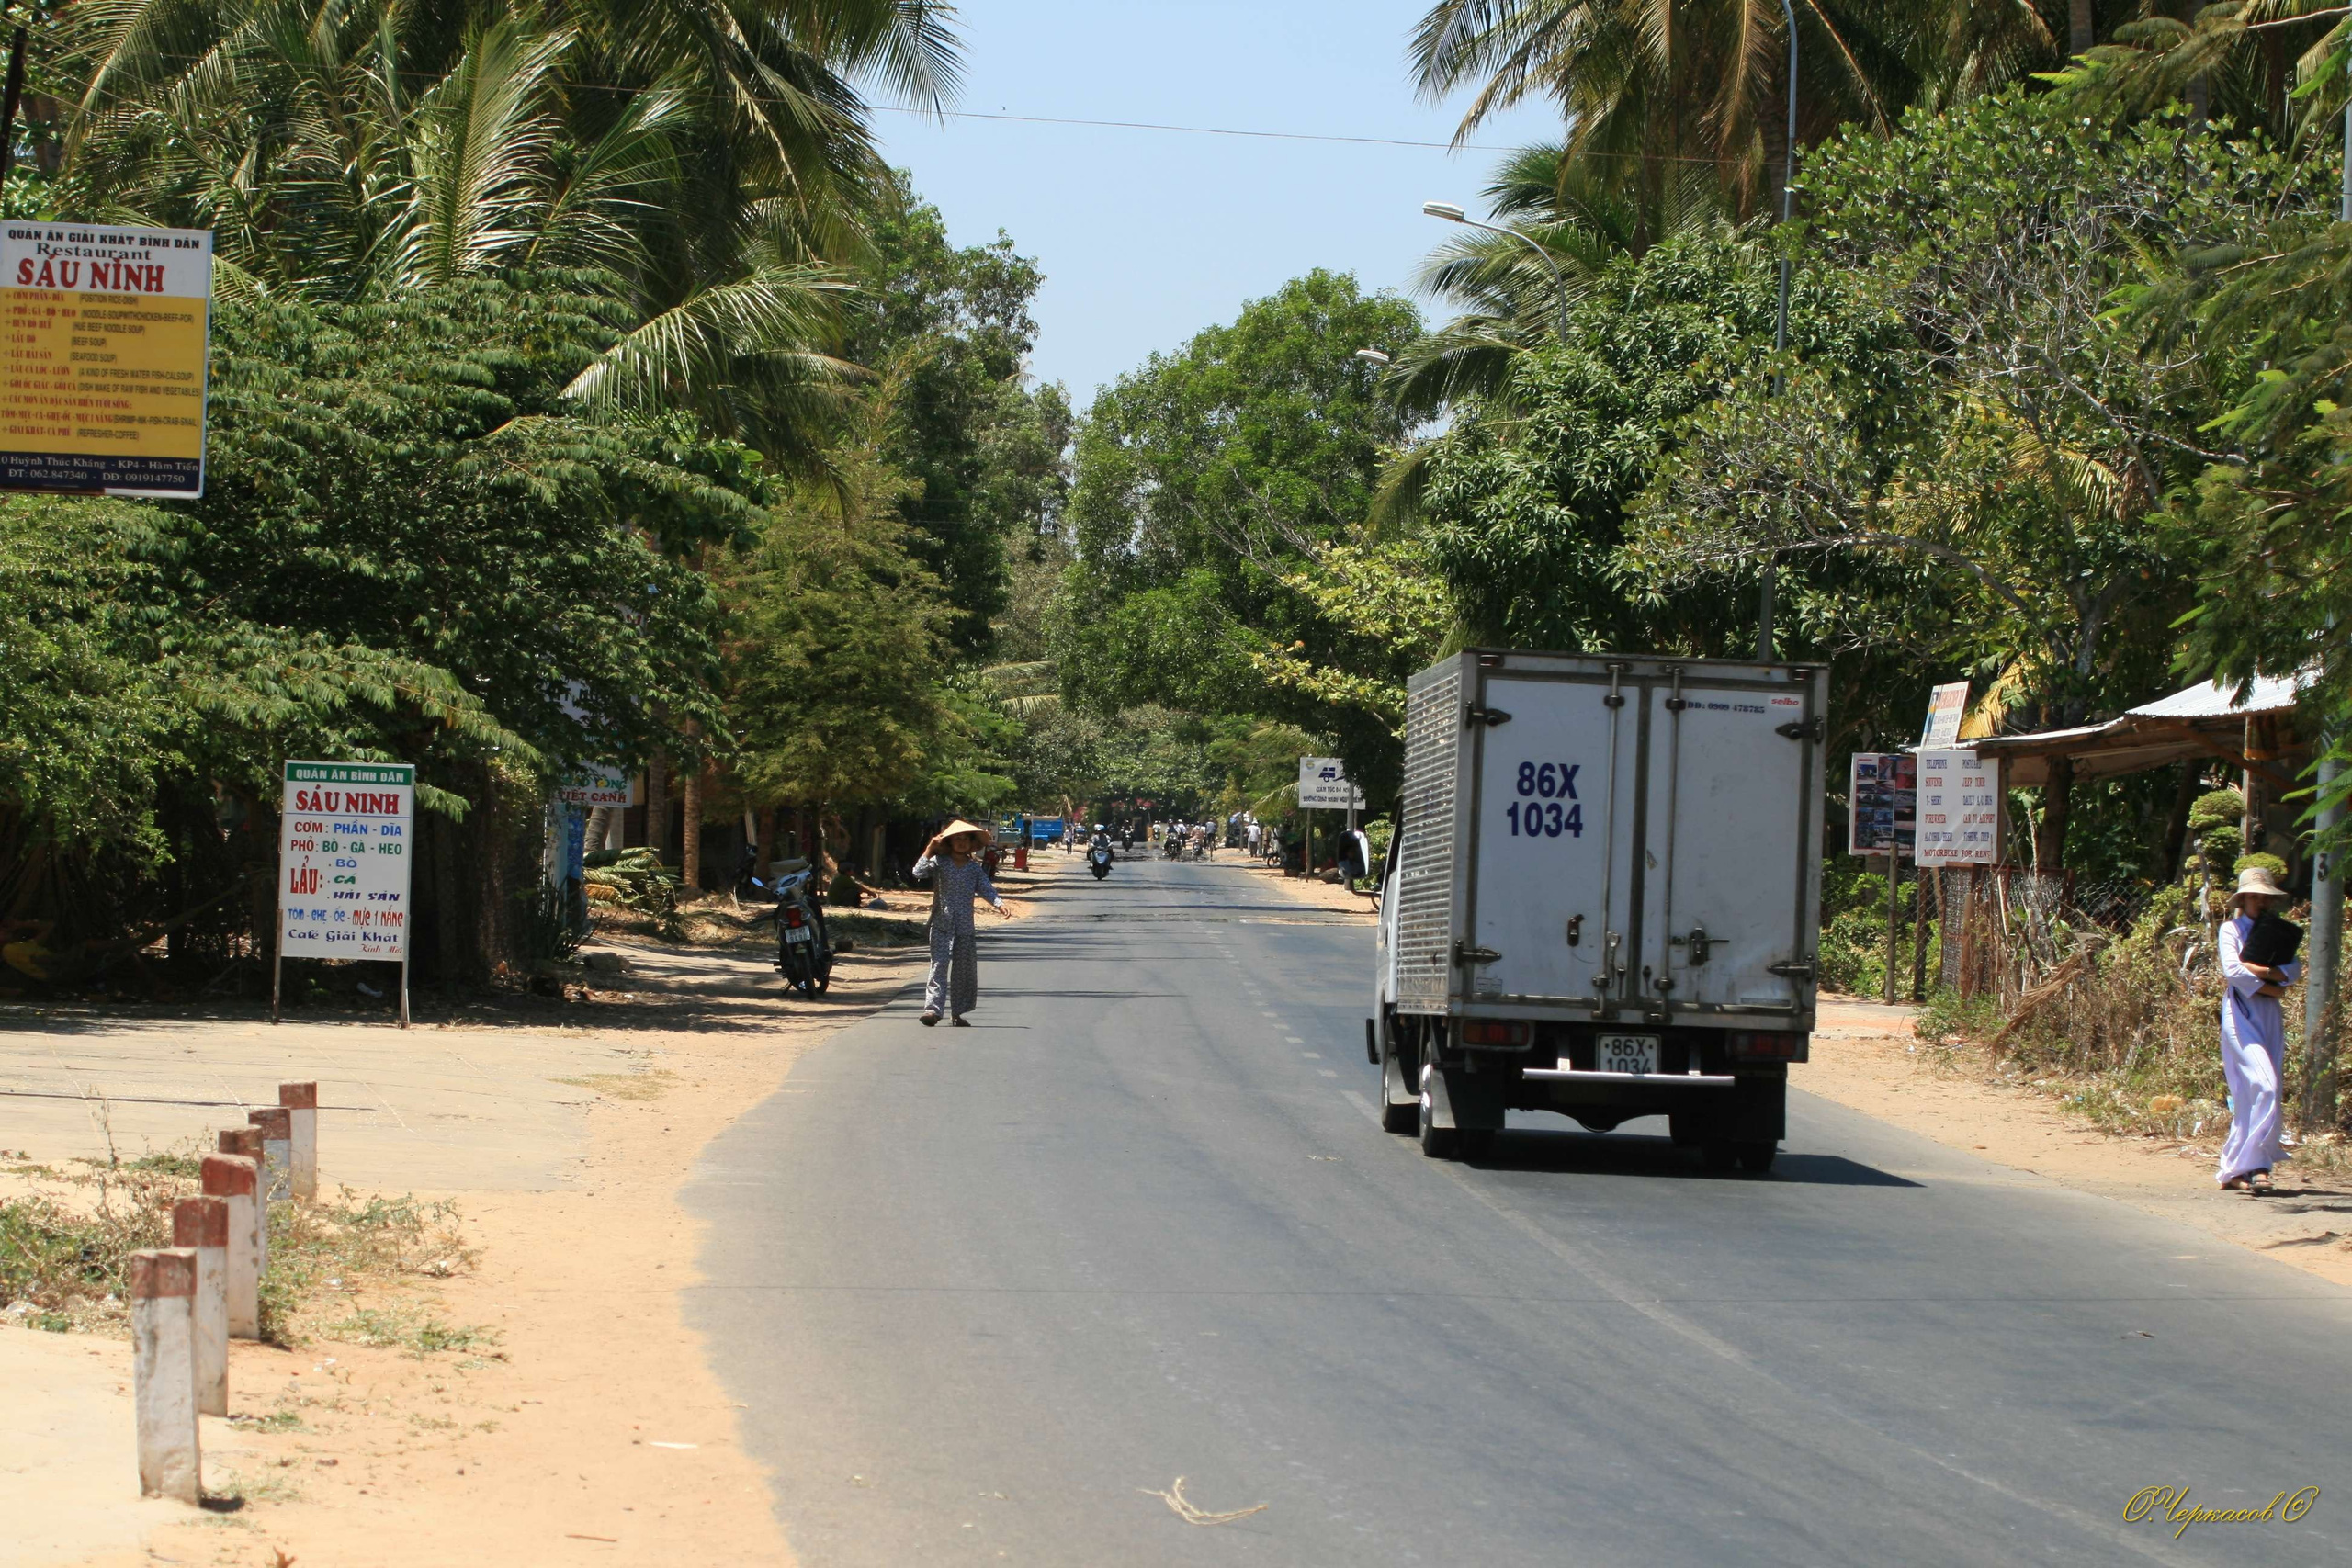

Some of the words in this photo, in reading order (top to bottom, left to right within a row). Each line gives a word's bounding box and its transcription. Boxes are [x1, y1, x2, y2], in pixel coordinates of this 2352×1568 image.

[8, 228, 42, 240] QUÁN
[47, 230, 64, 242] ĂN
[69, 230, 95, 243] GIẢI
[99, 232, 135, 245] KHÁT
[140, 234, 170, 248] BÌNH
[175, 236, 200, 250] DÂN
[37, 243, 152, 261] Restaurant
[17, 254, 81, 288] SÁU
[101, 369, 108, 378] OF
[112, 385, 119, 393] OF
[10, 457, 43, 468] Huỳnh
[45, 457, 71, 467] Thúc
[74, 458, 106, 469] Kháng
[119, 461, 140, 469] KP4
[149, 462, 173, 471] Hàm
[30, 469, 87, 480] 062.847340
[125, 473, 185, 484] 0919147750
[296, 768, 328, 780] QUÁN
[332, 769, 347, 781] ĂN
[351, 770, 377, 782] BÌNH
[380, 771, 404, 783] DÂN
[1517, 761, 1581, 800] 86X
[296, 784, 340, 813] SÁU
[345, 792, 400, 815] NINH
[591, 791, 628, 803] CANH
[1507, 802, 1583, 838] 1034
[322, 839, 339, 852] BÒ
[351, 840, 366, 854] GÀ
[379, 843, 402, 855] HEO
[1924, 849, 1959, 858] MOTORBIKE
[1962, 850, 1973, 858] FOR
[336, 857, 357, 868] BÒ
[334, 873, 356, 885] CÁ
[288, 907, 305, 920] TÔM
[288, 929, 319, 940] Café
[363, 931, 399, 943] Khát
[1612, 1039, 1645, 1057] 86X
[1607, 1058, 1652, 1074] 1034
